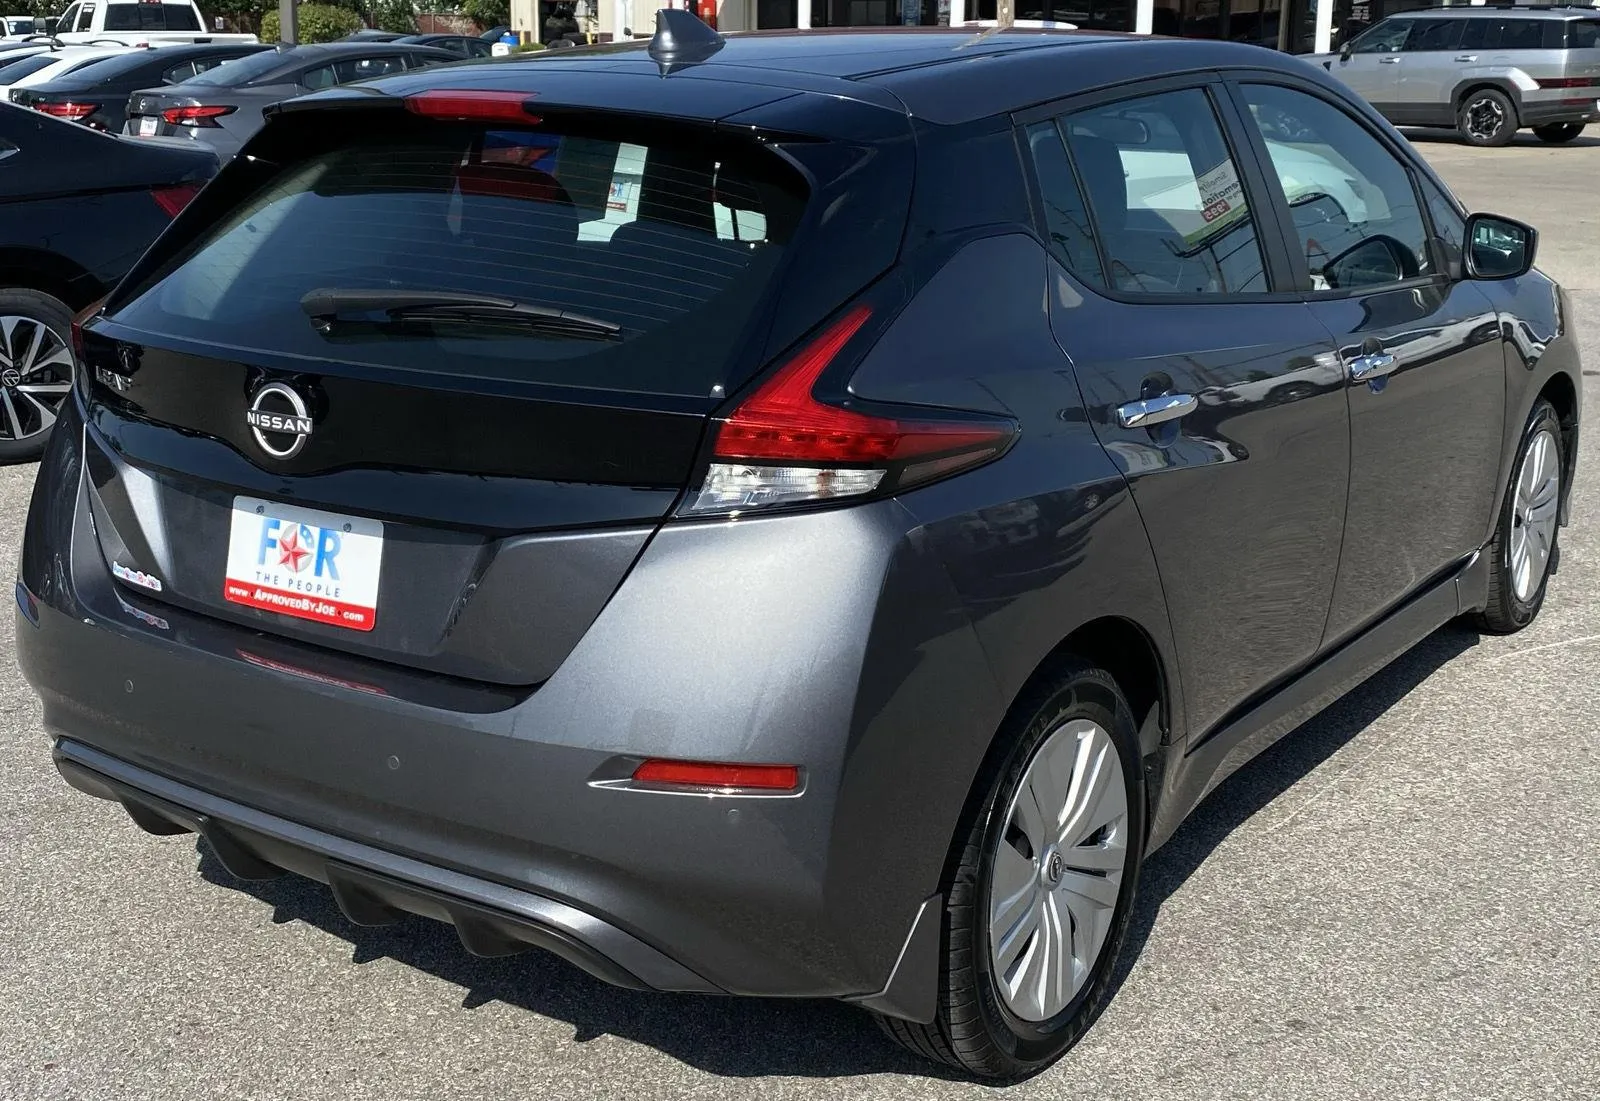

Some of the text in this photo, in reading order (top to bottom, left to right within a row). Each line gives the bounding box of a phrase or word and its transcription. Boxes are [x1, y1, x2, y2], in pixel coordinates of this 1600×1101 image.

[247, 411, 311, 432] NISSAN
[256, 571, 344, 598] THE PEOPLE
